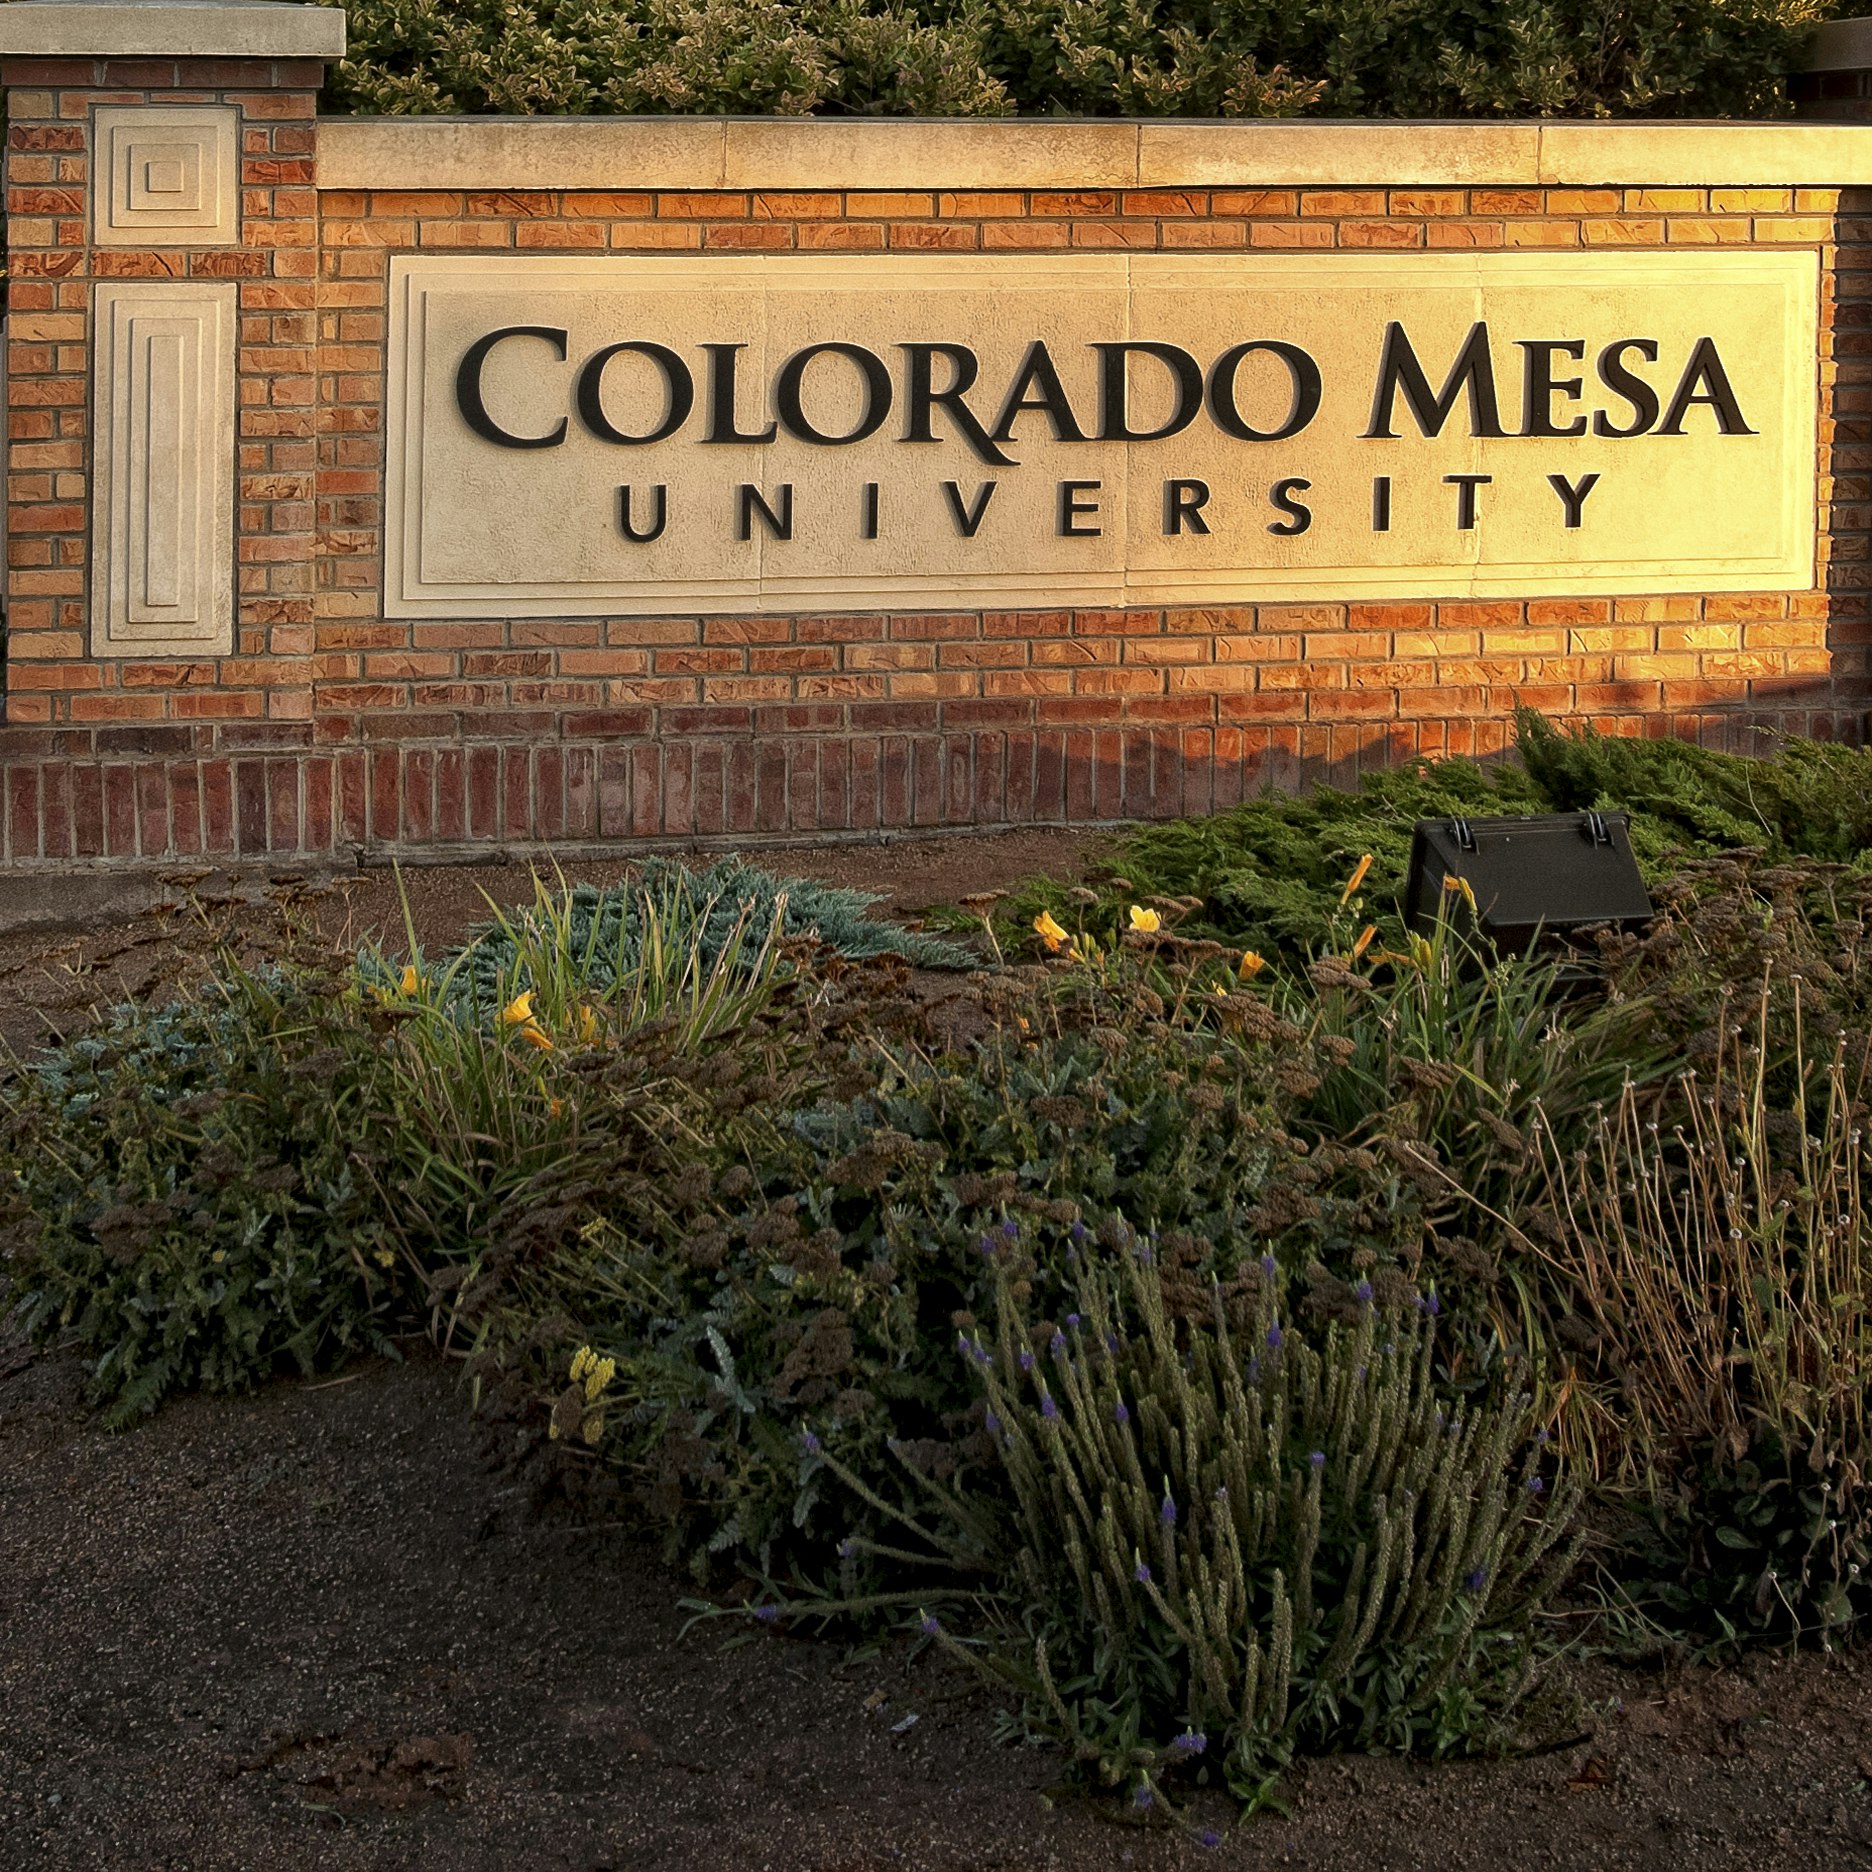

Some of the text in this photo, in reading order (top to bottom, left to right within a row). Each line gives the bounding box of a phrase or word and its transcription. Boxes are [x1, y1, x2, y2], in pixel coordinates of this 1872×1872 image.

[455, 320, 1760, 466] COLORADO MESA
[616, 473, 1601, 544] UNIVERSITY
